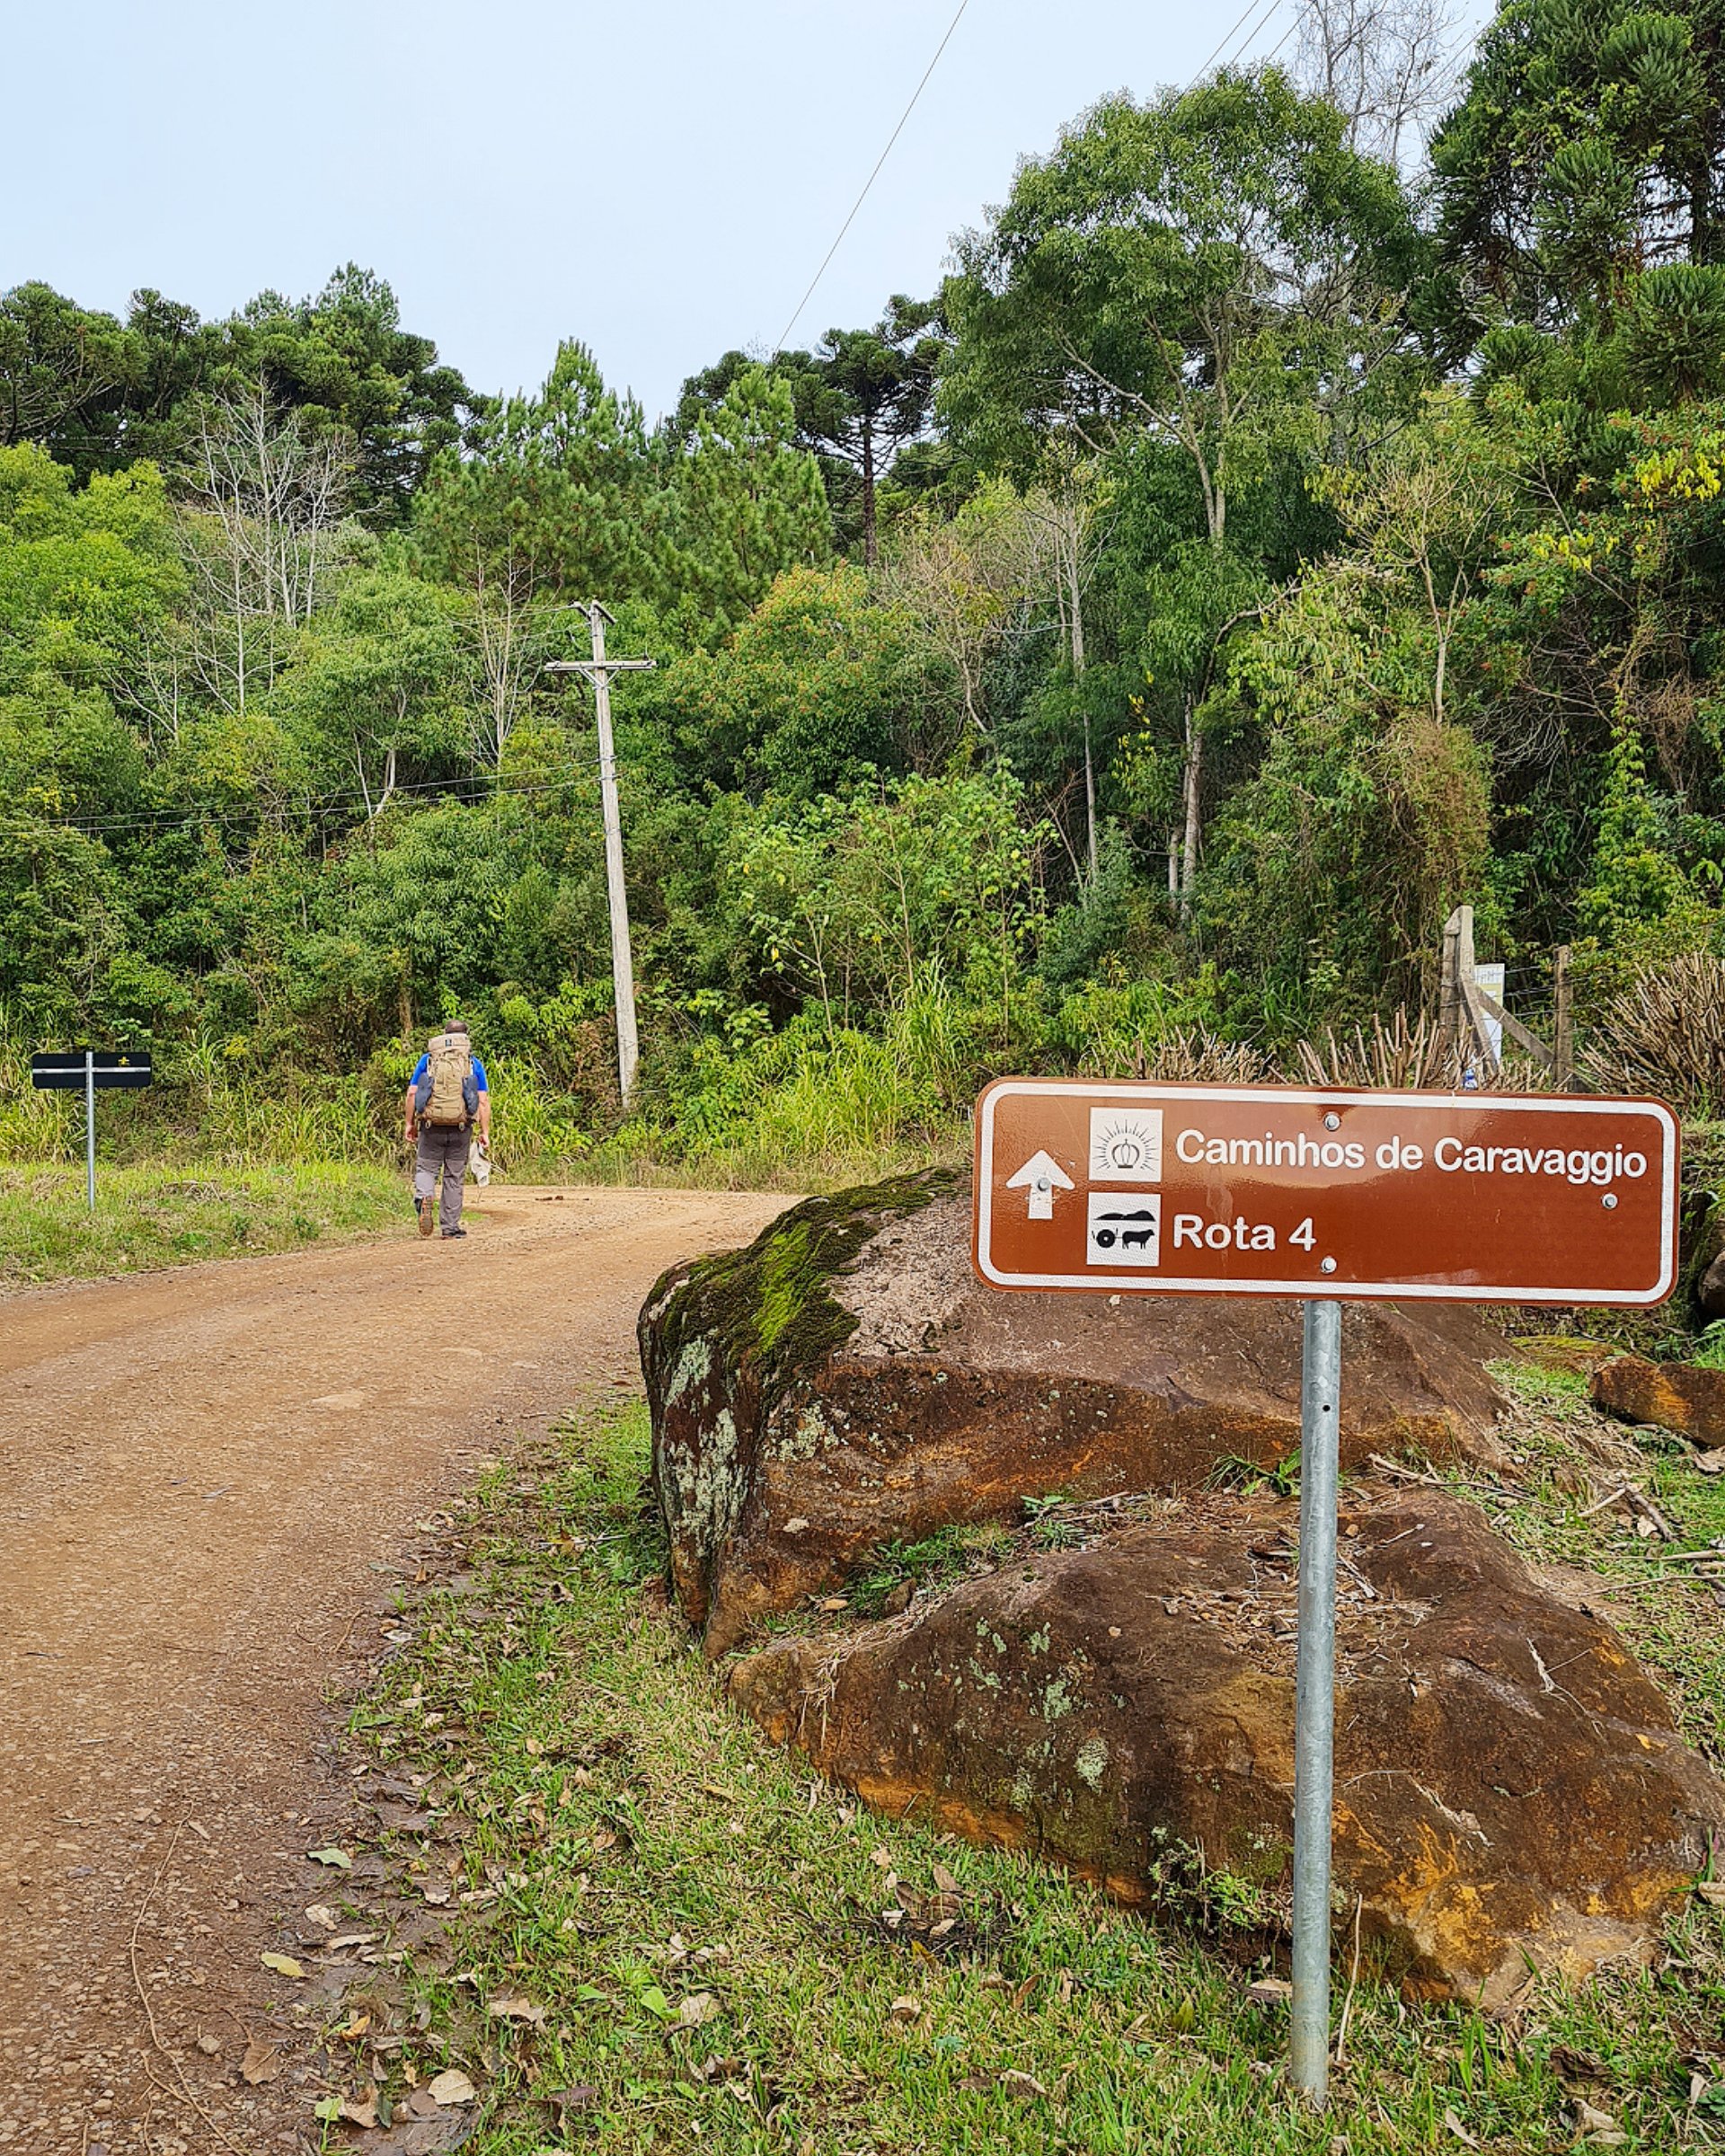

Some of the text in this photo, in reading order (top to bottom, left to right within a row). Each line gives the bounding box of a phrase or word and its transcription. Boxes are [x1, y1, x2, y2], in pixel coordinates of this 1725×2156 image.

[1174, 1128, 1647, 1186] Caminhos de Caravaggio
[1173, 1214, 1317, 1251] Rota 4
